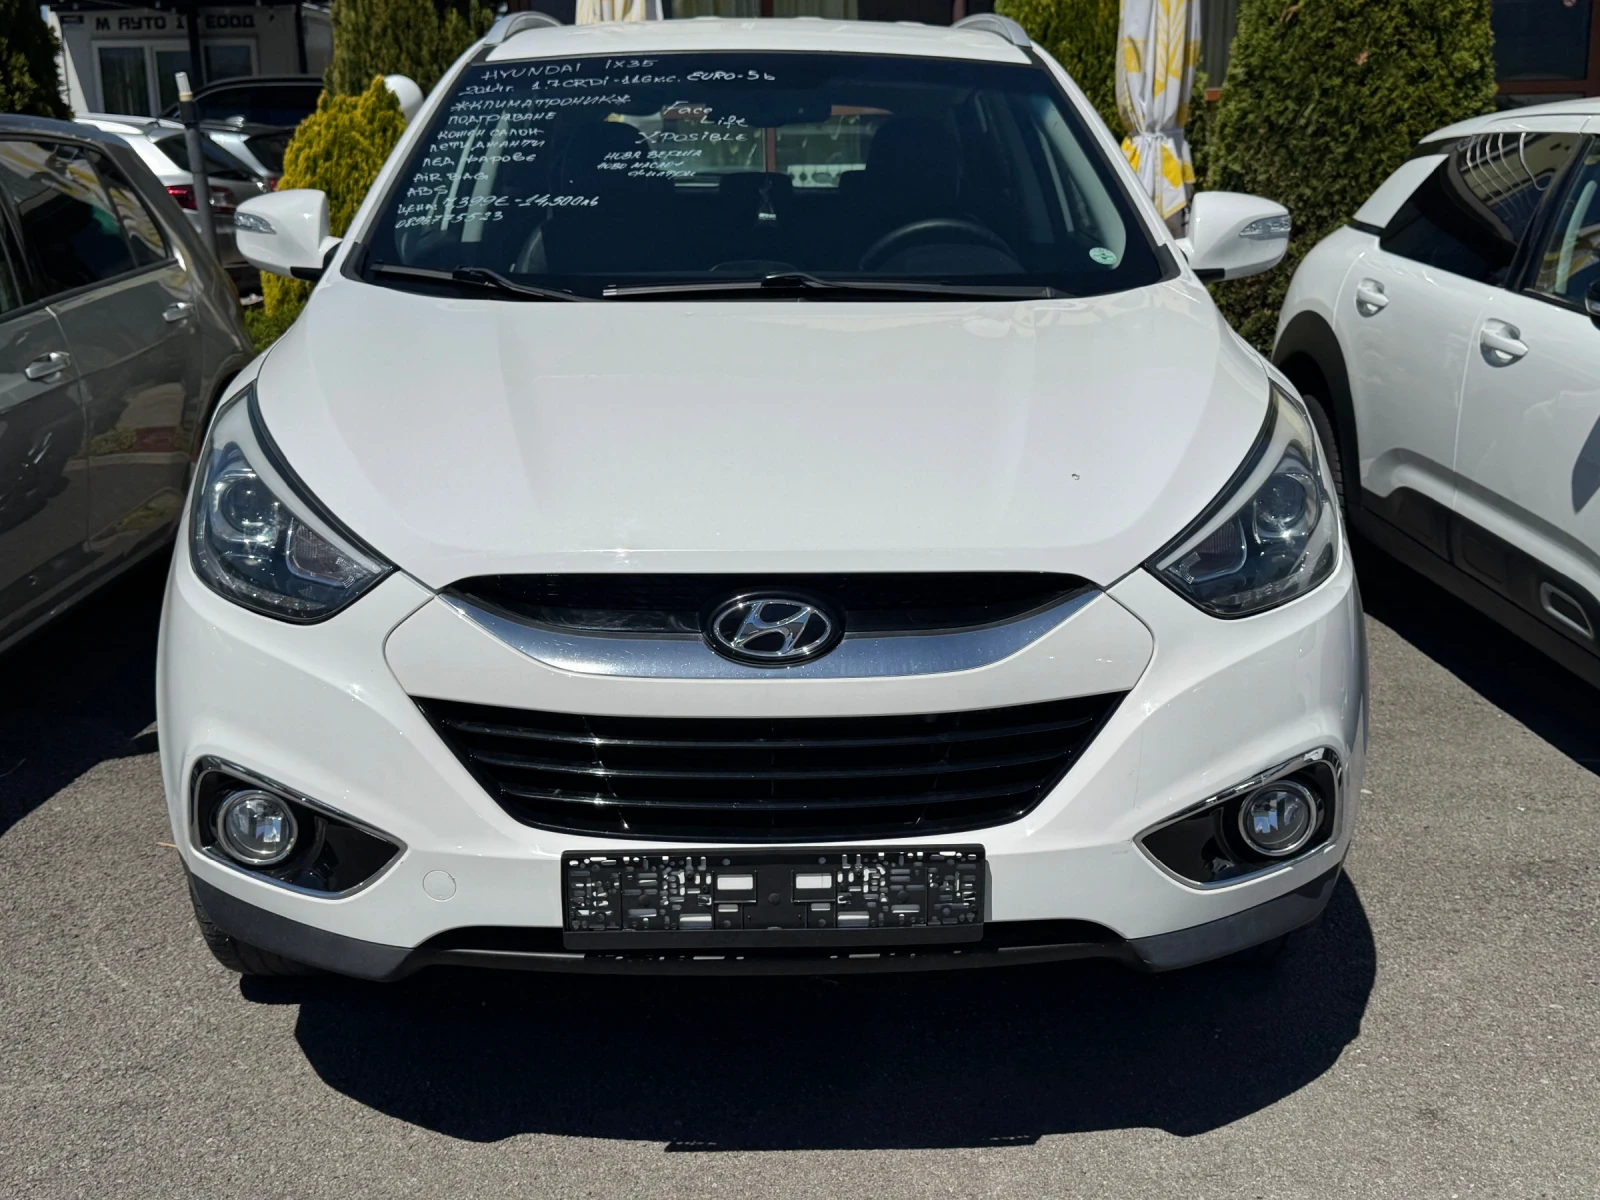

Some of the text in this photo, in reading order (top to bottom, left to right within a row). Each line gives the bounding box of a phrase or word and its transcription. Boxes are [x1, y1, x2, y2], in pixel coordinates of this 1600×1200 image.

[480, 62, 582, 81] HYUNDAI
[662, 100, 713, 115] Face
[490, 127, 545, 137] САЛОН
[422, 156, 455, 167] ЛЕД
[406, 185, 449, 198] ABS
